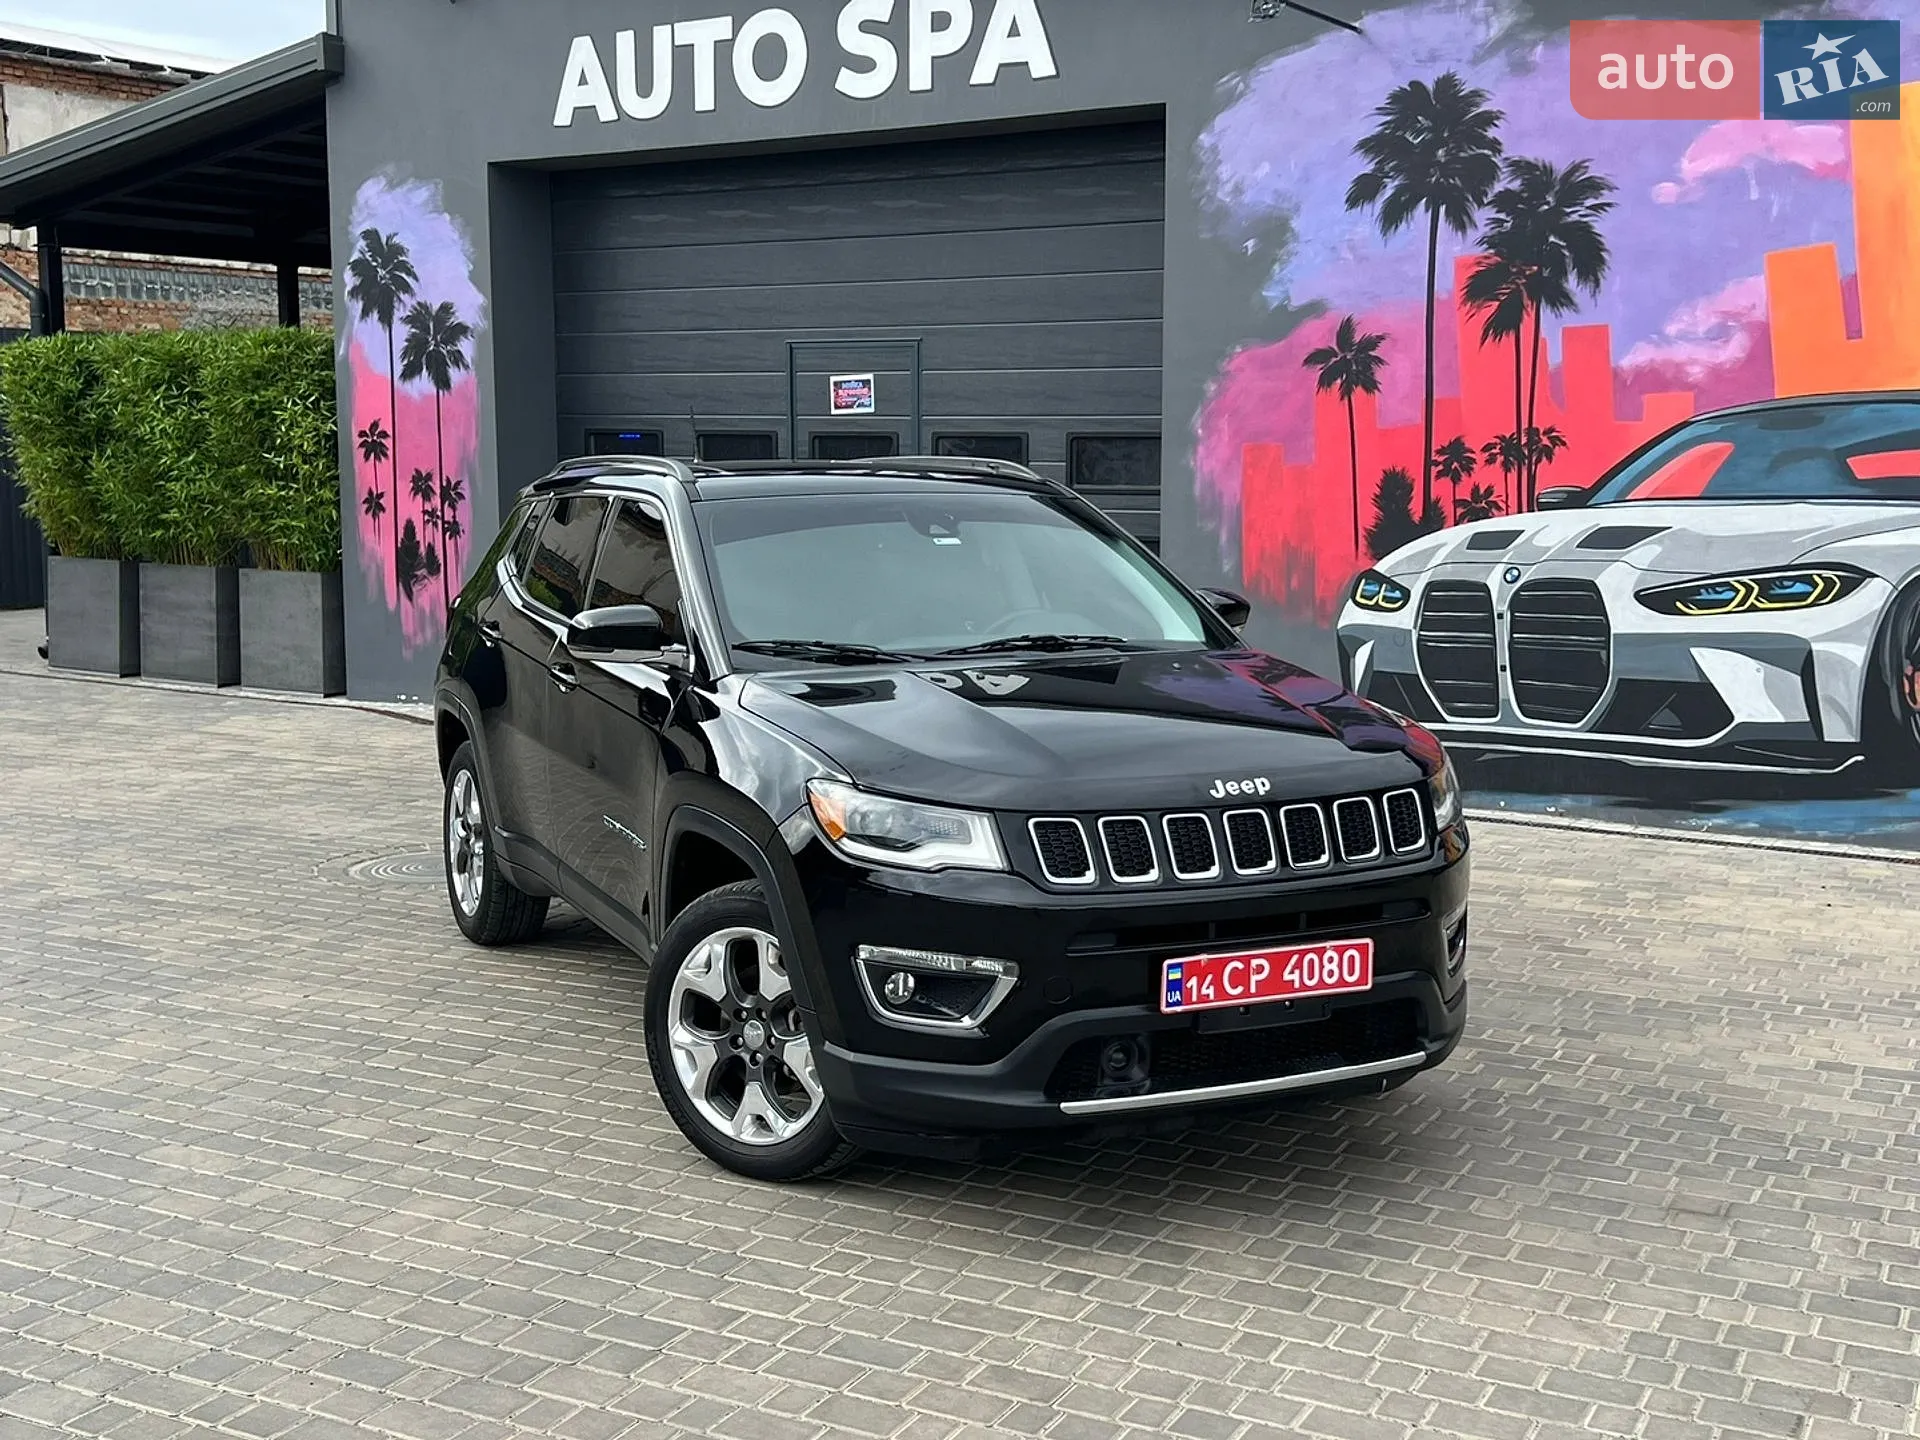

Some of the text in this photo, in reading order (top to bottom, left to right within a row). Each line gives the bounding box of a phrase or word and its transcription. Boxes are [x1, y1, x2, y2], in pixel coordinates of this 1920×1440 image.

[552, 0, 1058, 127] AUTO SPA
[1209, 777, 1271, 799] Jeep
[1185, 948, 1361, 1002] 14 CP 4080
[1167, 992, 1182, 1003] UA
